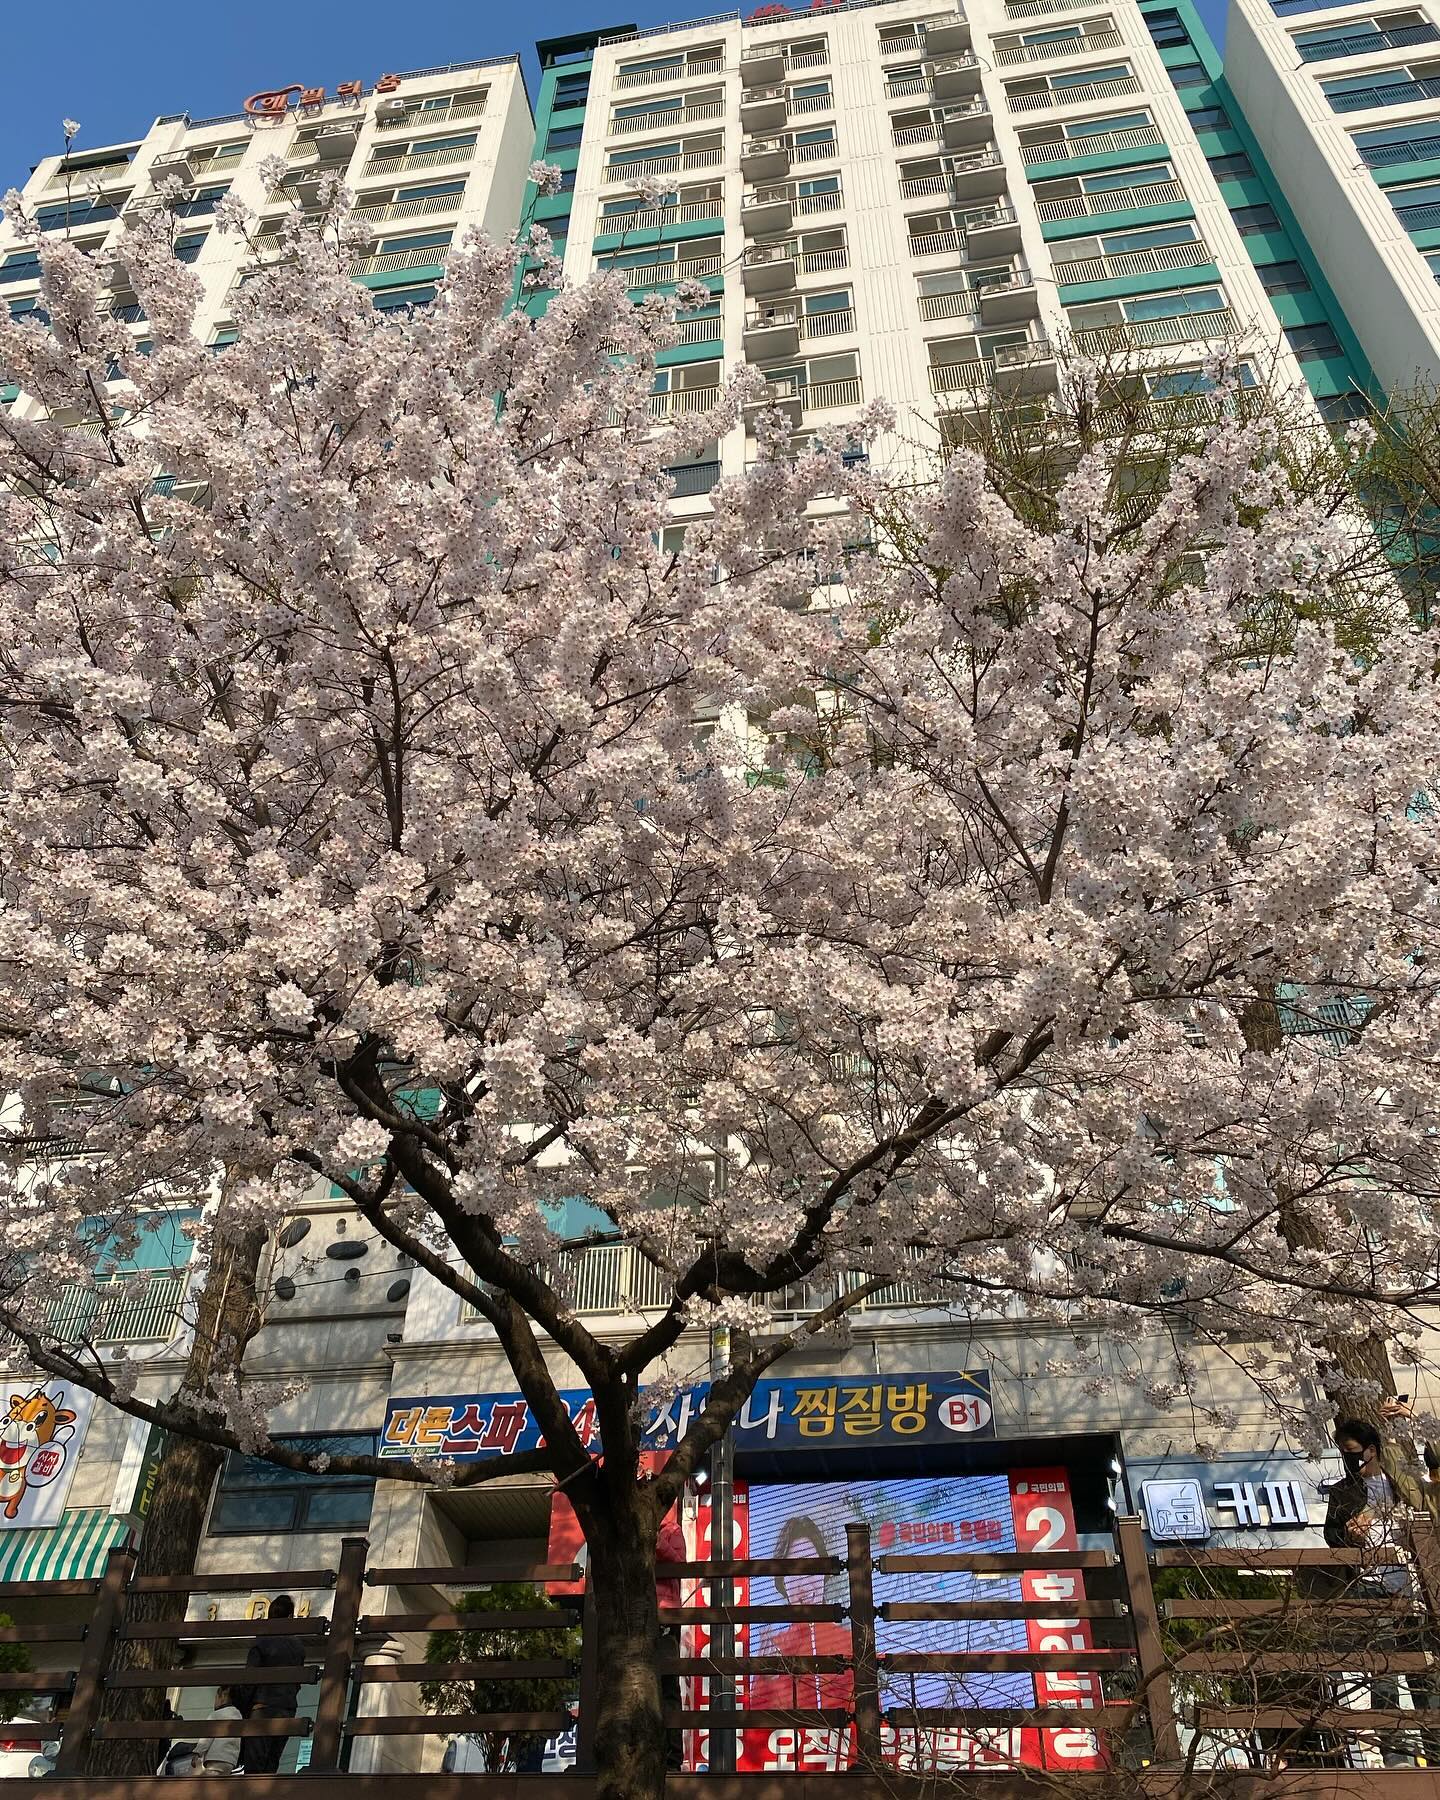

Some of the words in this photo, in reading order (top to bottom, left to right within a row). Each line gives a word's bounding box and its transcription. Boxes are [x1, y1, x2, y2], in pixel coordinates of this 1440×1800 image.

[386, 1401, 527, 1453] 더존스파
[644, 1389, 784, 1443] 사나
[791, 1383, 932, 1437] 찜질방
[949, 1400, 982, 1426] B1
[1031, 1482, 1066, 1493] 국민의힘
[1213, 1480, 1308, 1524] 커피
[1025, 1506, 1070, 1553] 2
